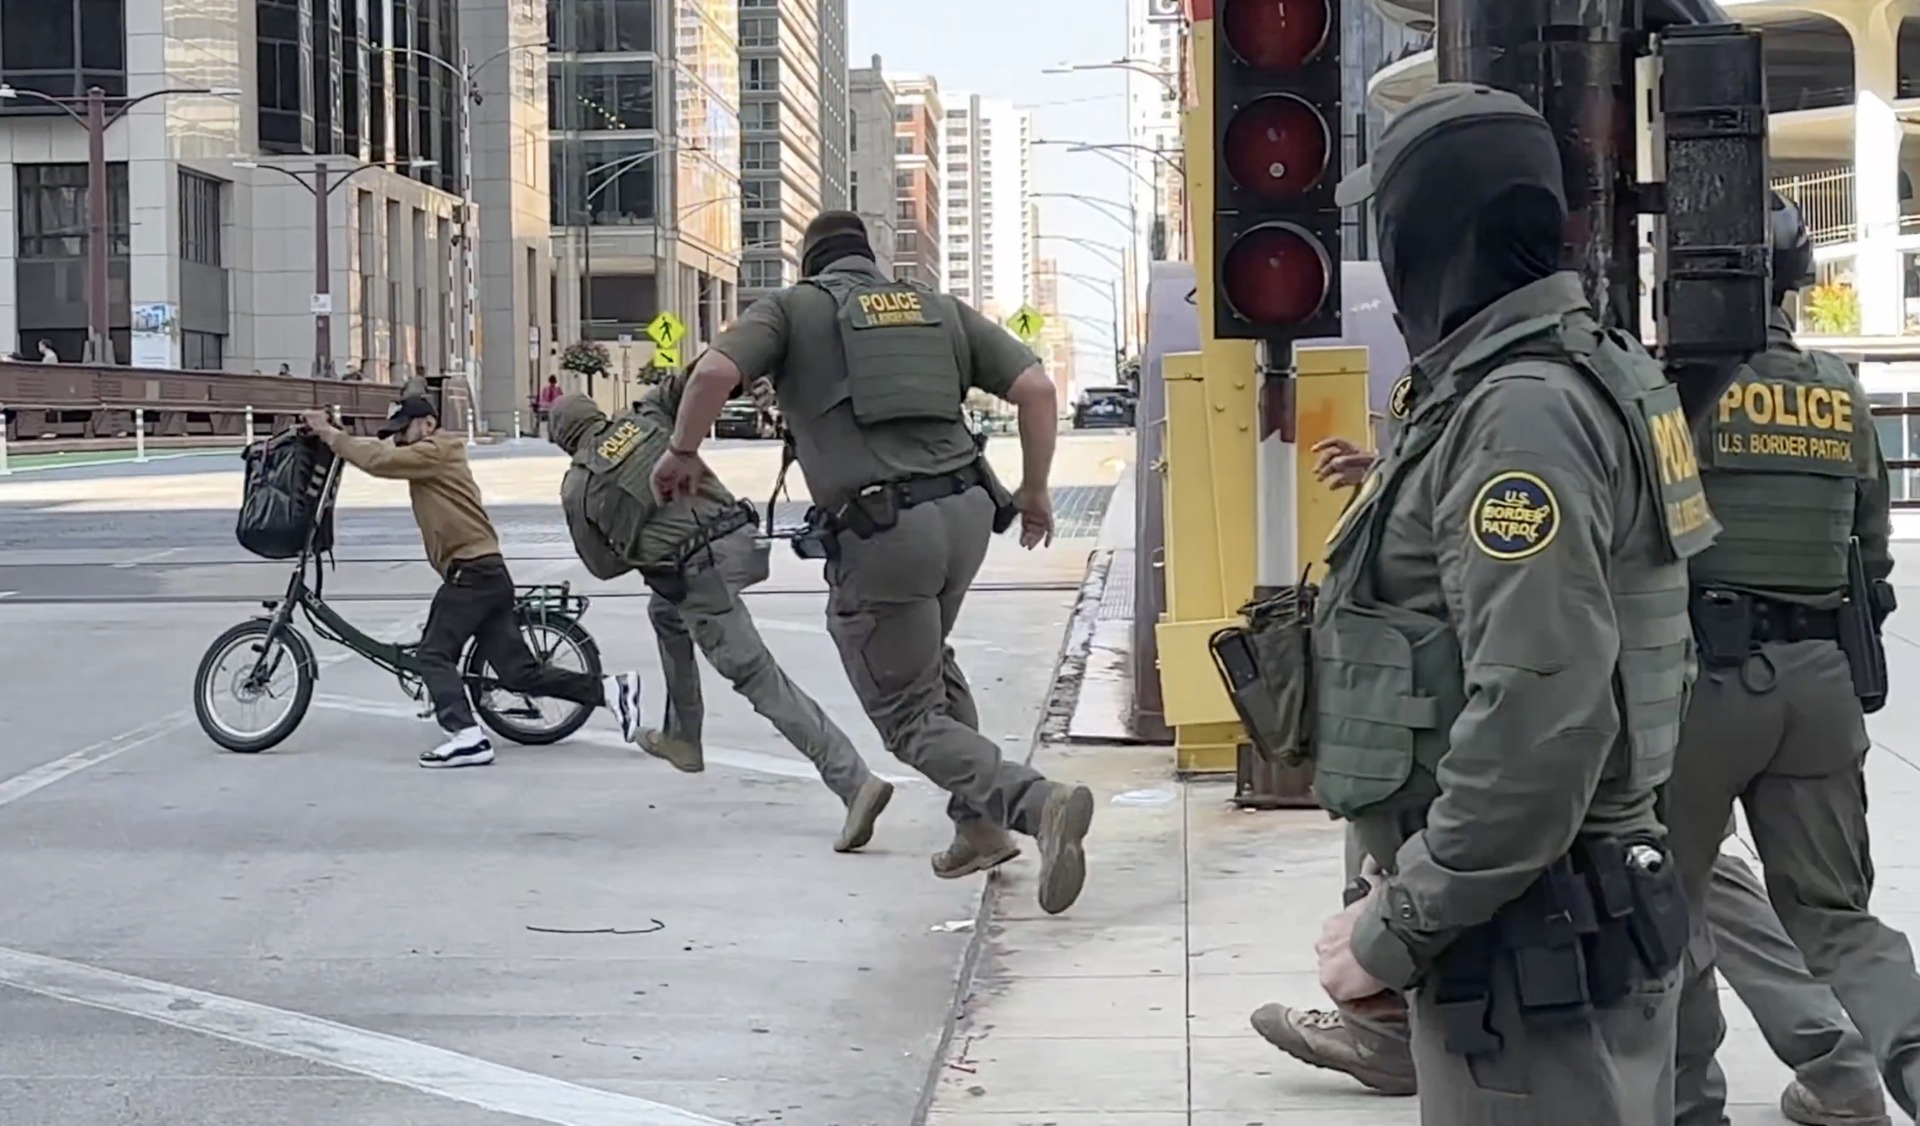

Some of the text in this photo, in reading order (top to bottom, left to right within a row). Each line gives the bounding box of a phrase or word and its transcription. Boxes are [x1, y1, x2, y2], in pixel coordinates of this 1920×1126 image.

[858, 291, 922, 313] POLICE
[1718, 382, 1853, 432] POLICE
[597, 420, 641, 460] POLICE
[1718, 432, 1853, 462] U.S. BORDER PATROL
[1482, 506, 1544, 523] BORDER
[1481, 519, 1540, 538] PATROL
